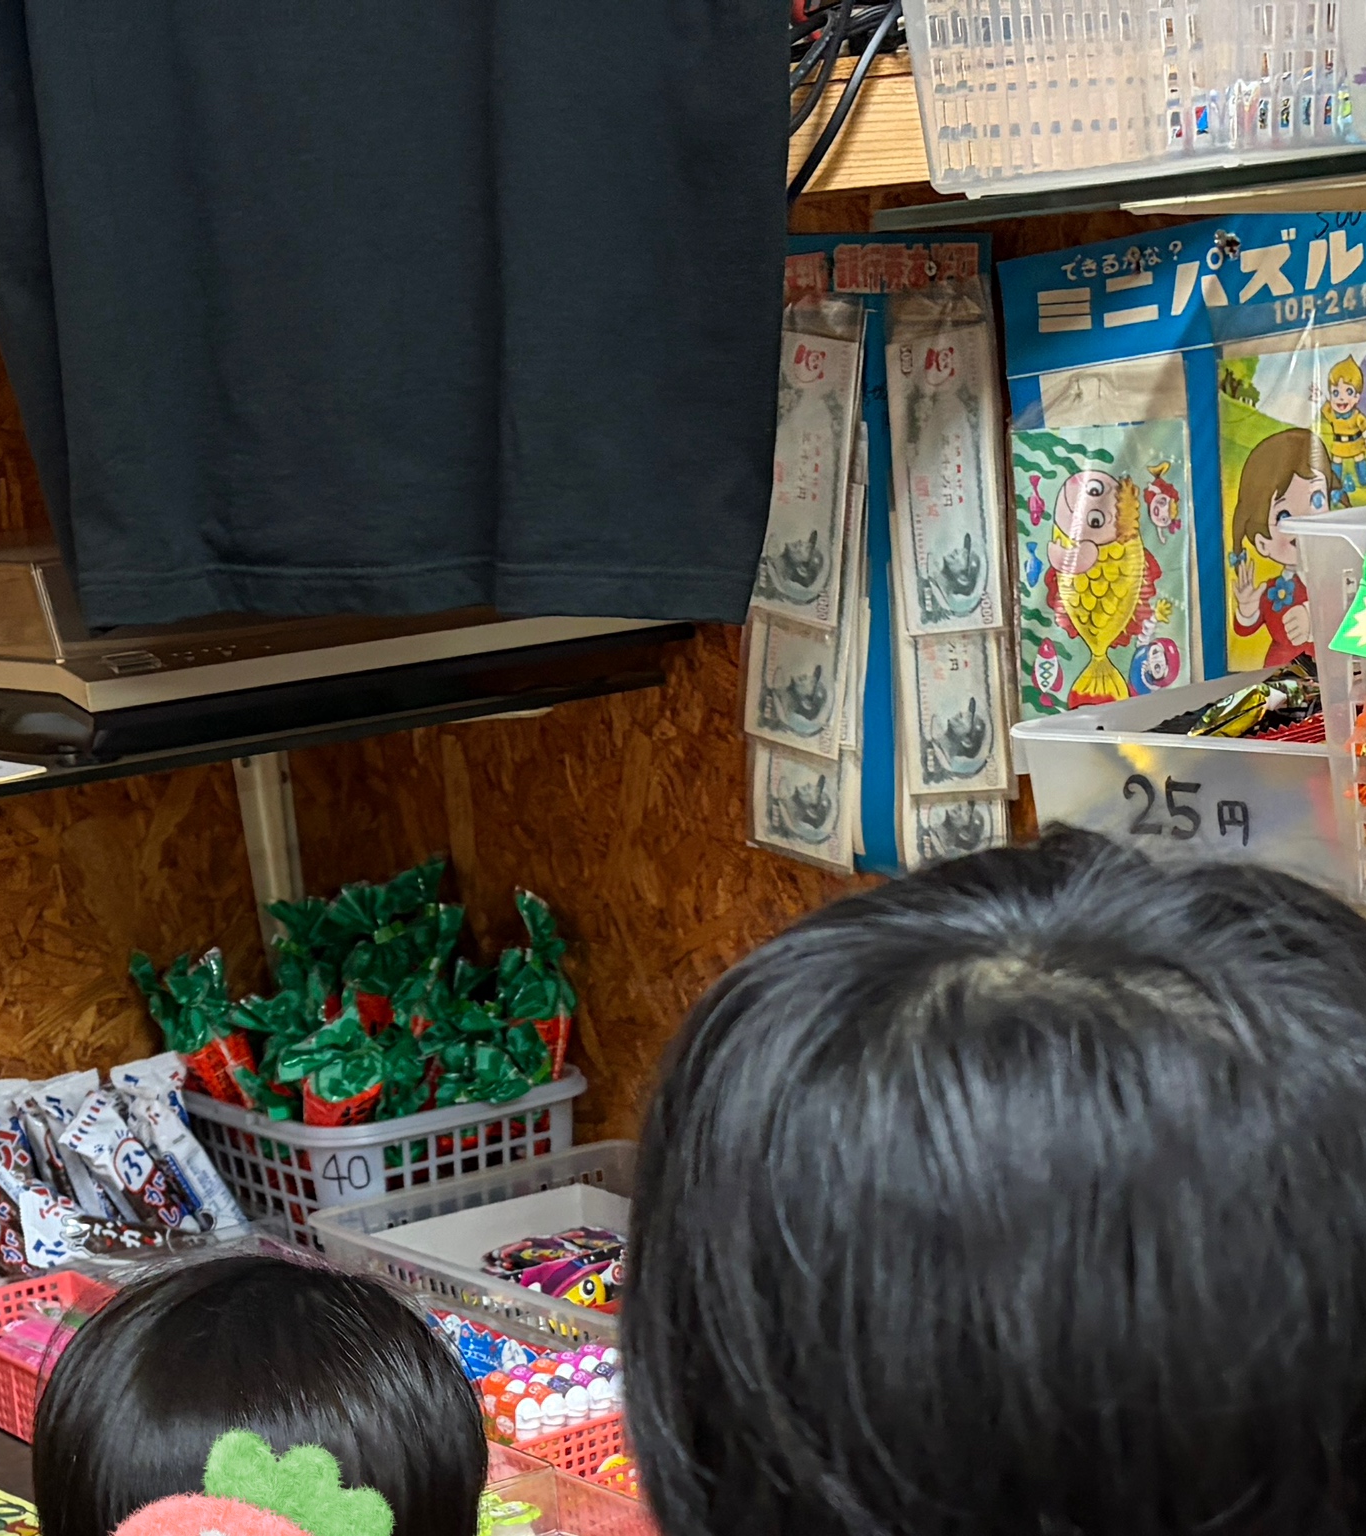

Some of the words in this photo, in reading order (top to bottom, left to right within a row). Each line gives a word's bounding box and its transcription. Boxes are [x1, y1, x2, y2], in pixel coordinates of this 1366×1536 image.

[1036, 228, 1365, 334] ミニパズル
[320, 1152, 372, 1197] 40
